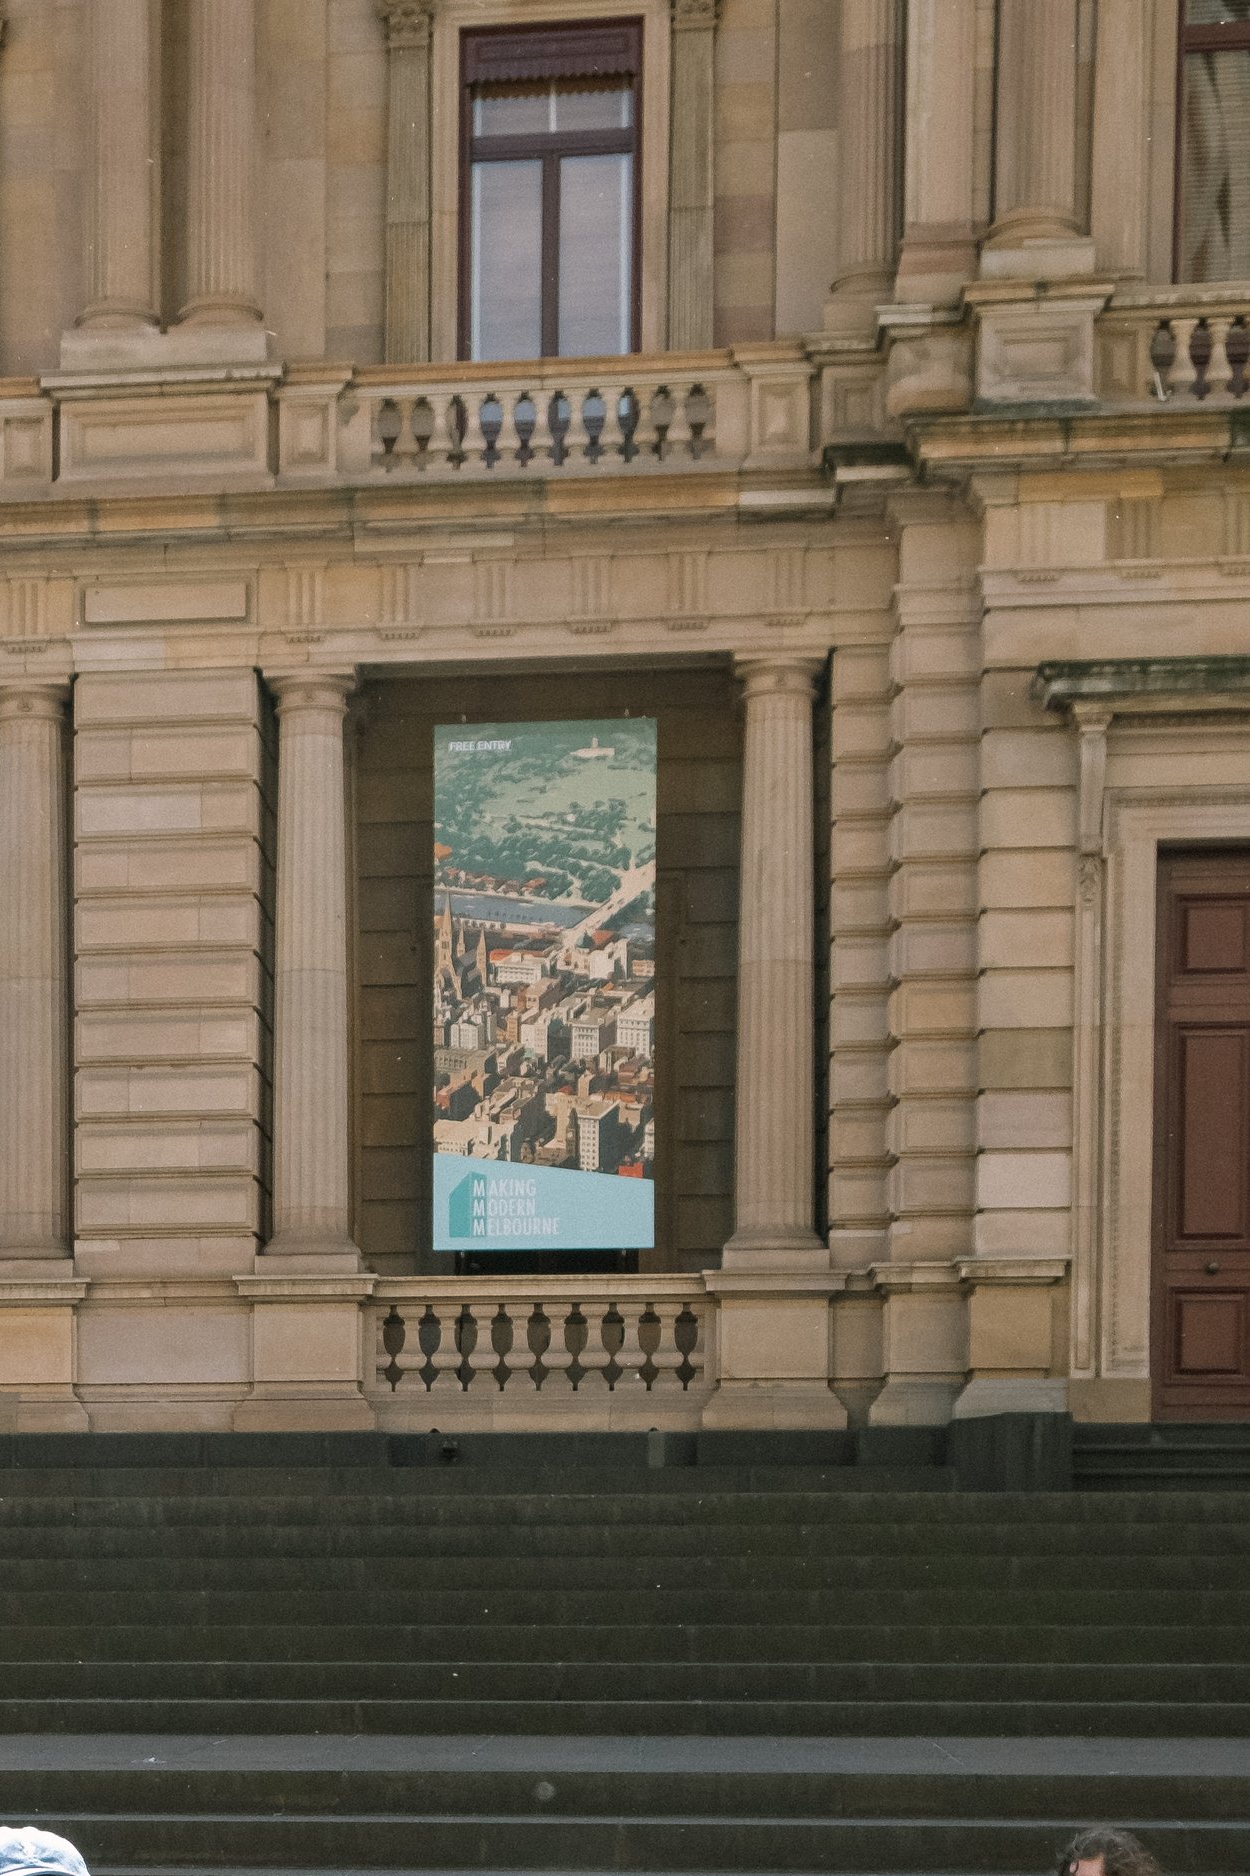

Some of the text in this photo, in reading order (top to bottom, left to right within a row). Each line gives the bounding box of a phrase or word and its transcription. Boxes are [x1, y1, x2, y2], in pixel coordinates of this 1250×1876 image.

[449, 740, 512, 751] FREE ENTRY
[473, 1179, 537, 1197] MAKING
[473, 1198, 536, 1217] MODERN
[473, 1217, 559, 1236] MELBOURNE
